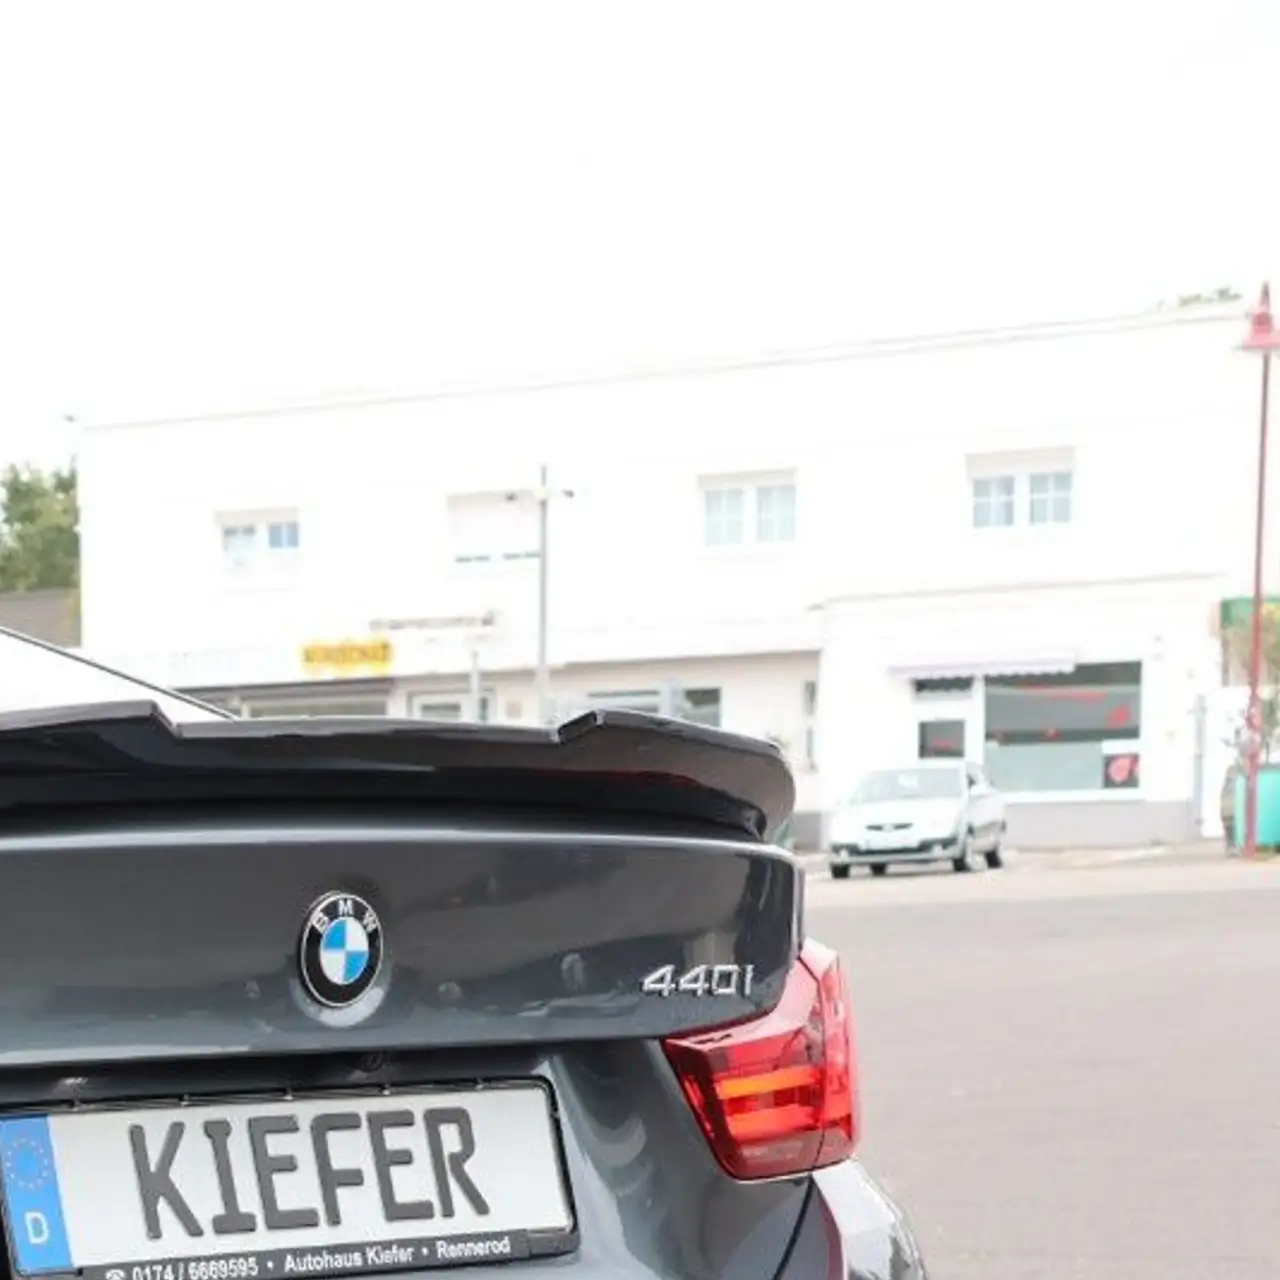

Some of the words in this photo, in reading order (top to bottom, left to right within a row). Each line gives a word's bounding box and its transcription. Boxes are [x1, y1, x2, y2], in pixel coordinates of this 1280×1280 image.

[313, 898, 378, 934] BMW
[129, 1106, 490, 1239] KIEFER
[24, 1211, 50, 1245] D
[283, 1252, 362, 1273] Autohaus
[365, 1244, 415, 1266] Kiefer
[436, 1236, 511, 1259] Rennerod
